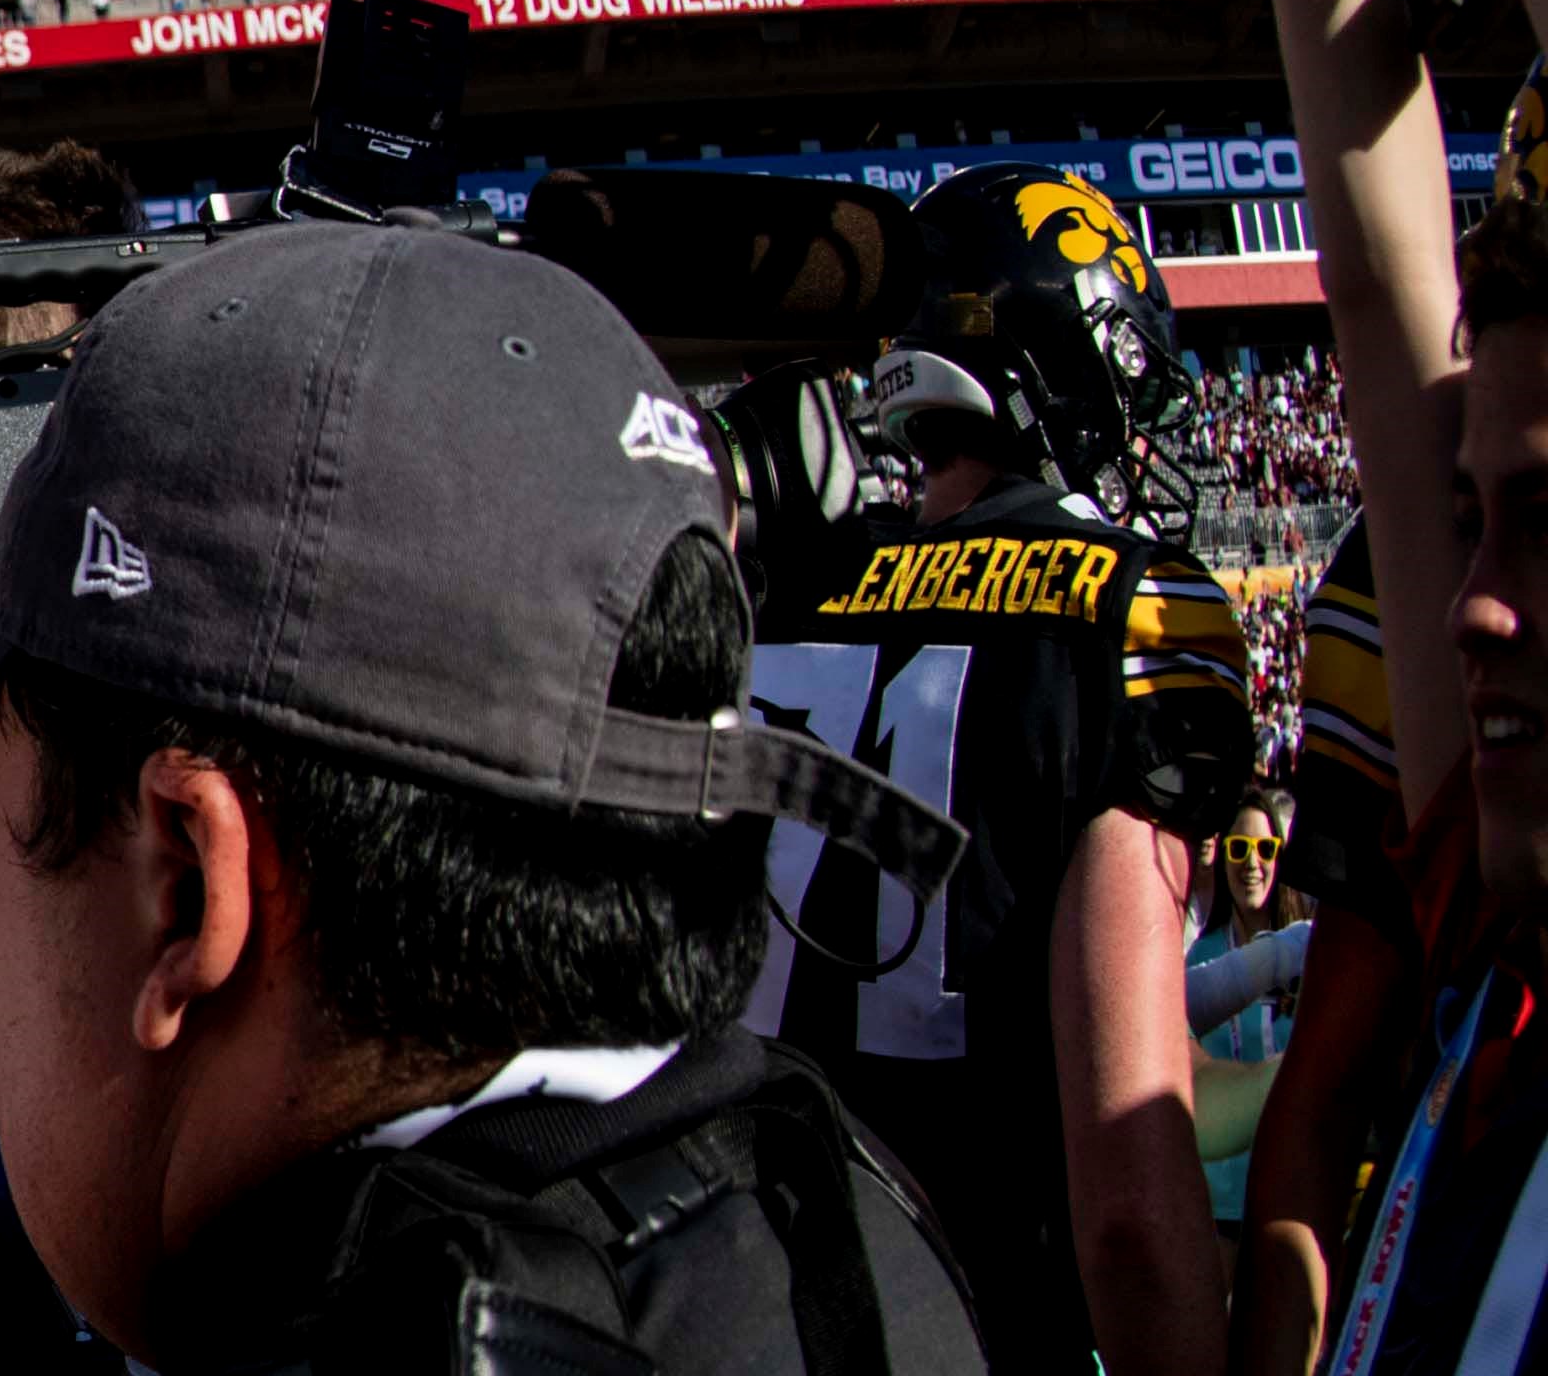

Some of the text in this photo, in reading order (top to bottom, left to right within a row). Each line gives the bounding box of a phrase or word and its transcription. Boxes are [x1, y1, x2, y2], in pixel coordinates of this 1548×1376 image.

[130, 0, 329, 56] JOHN MCK
[862, 165, 922, 195] Bay
[1128, 138, 1306, 194] GEICO
[1370, 1176, 1416, 1286] BOWL
